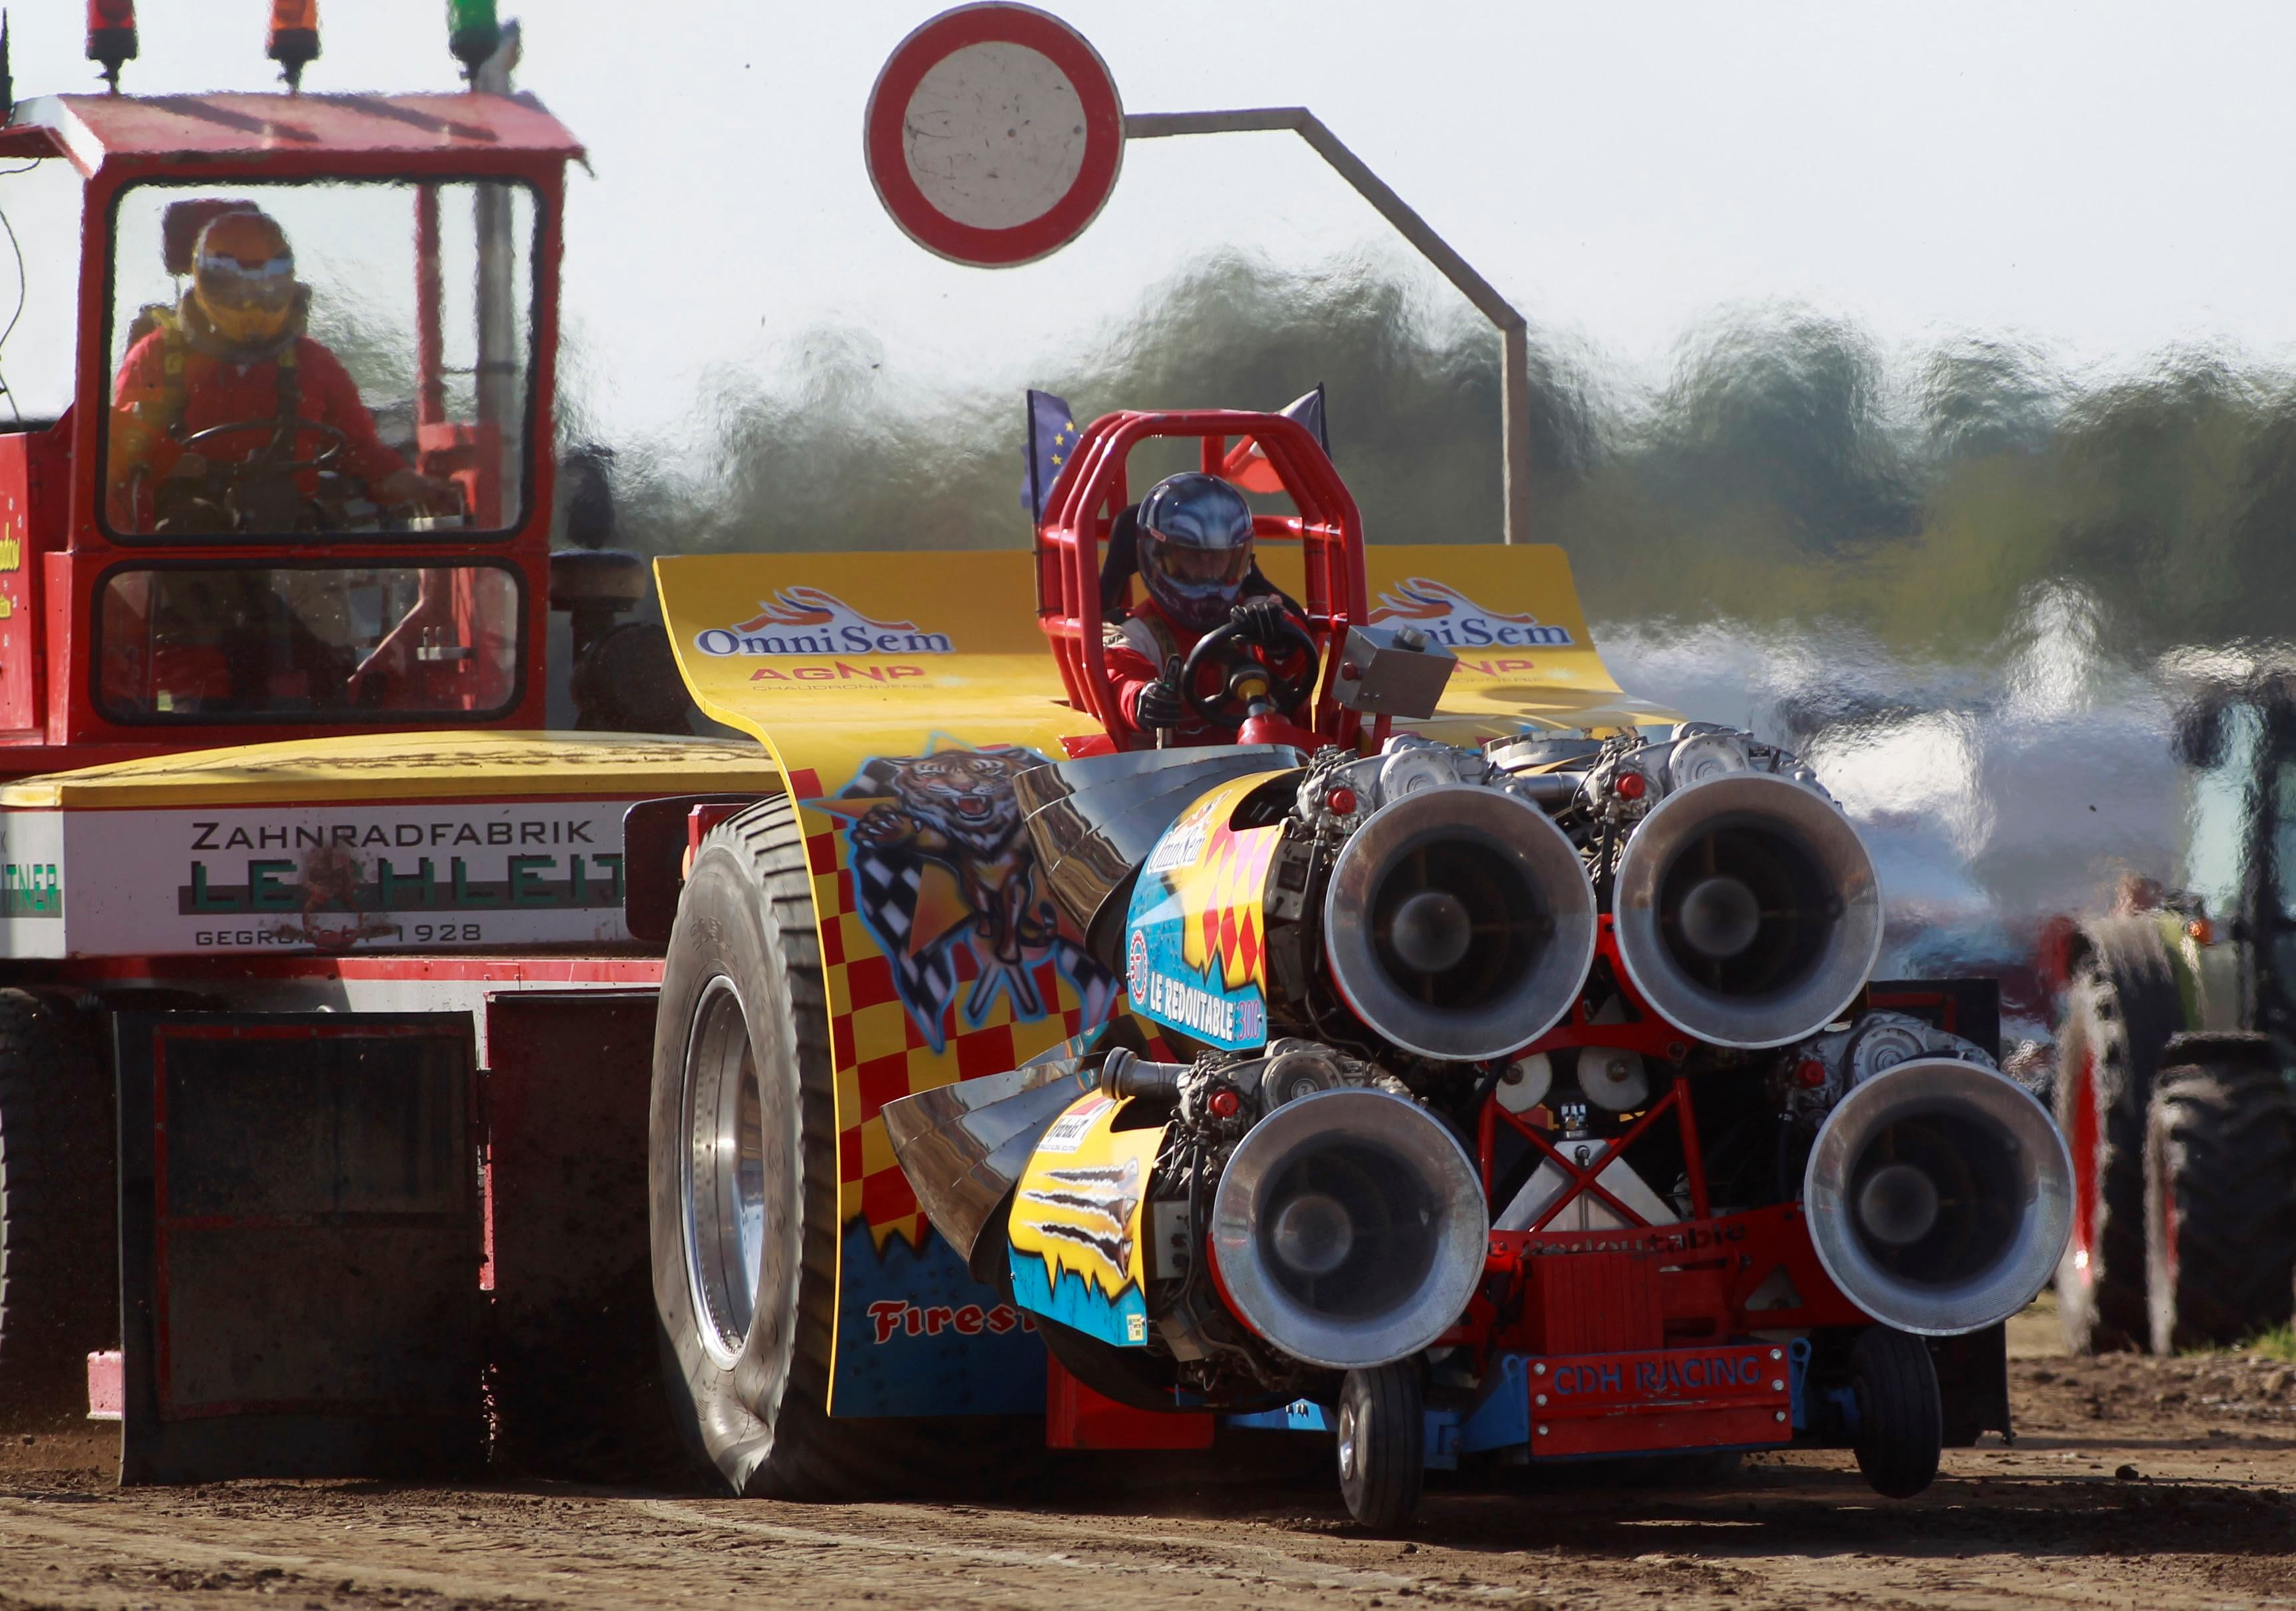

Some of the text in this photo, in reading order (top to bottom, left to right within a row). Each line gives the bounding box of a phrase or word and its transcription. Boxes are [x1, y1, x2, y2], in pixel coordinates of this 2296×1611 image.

[698, 625, 951, 655] OmniSem
[749, 660, 927, 682] AGNP
[191, 820, 595, 850] ZAHNRADFABRIK
[397, 924, 481, 943] 1928
[1150, 971, 1260, 1042] LE REDOUTABLE 300
[1554, 1356, 1761, 1395] CDH RACING
